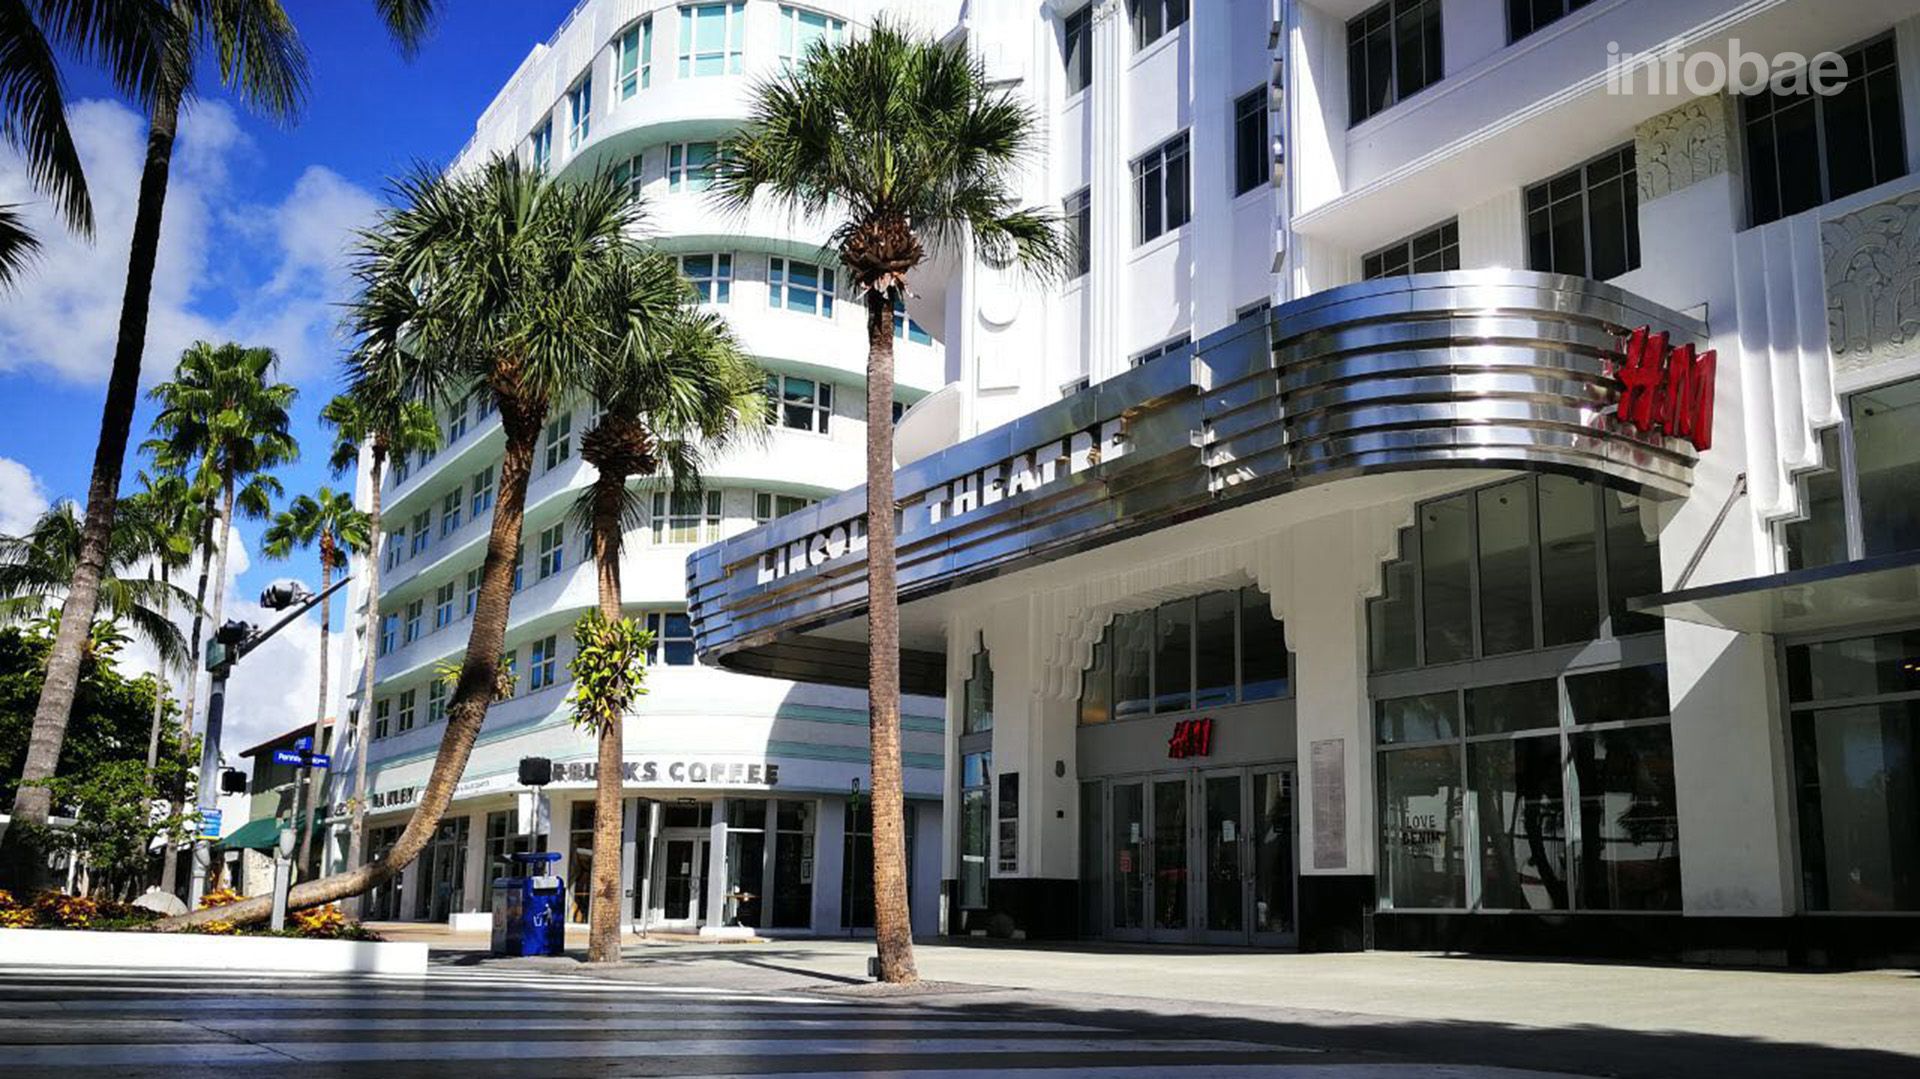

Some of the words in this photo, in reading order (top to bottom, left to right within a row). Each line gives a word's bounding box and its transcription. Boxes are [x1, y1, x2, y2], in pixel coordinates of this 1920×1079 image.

[757, 516, 869, 585] LINCOL
[926, 417, 1125, 525] THEATRE
[1168, 717, 1210, 758] HM
[669, 761, 780, 785] COFFEE
[1406, 815, 1436, 829] LOVE
